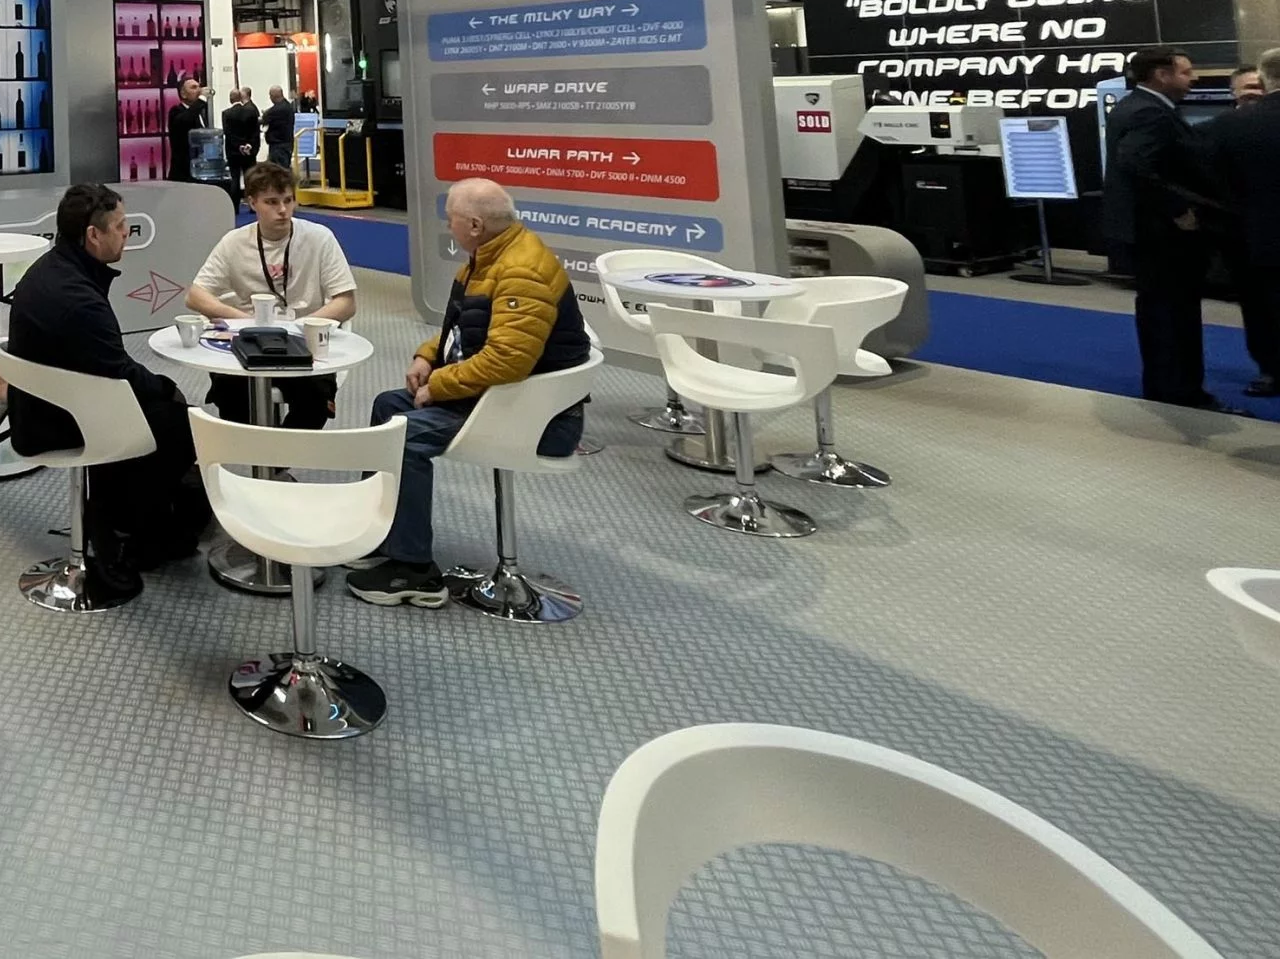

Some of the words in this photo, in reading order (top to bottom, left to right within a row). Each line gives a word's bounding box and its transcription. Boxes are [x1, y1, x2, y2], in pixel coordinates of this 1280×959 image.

[489, 13, 518, 26] THE
[523, 8, 573, 24] MILKY
[578, 5, 616, 19] WAY
[888, 20, 1028, 47] WHERE
[1040, 16, 1107, 41] NO
[504, 82, 549, 94] WARP
[554, 81, 609, 93] DRIVE
[798, 114, 830, 129] SOLD
[507, 147, 561, 160] LUNAR
[566, 149, 613, 163] PATH
[566, 169, 585, 178] 5700
[590, 170, 608, 180] DVF
[608, 172, 628, 181] 5000
[640, 173, 663, 183] DNM
[663, 175, 687, 185] 4500
[585, 217, 677, 237] ACADEMY
